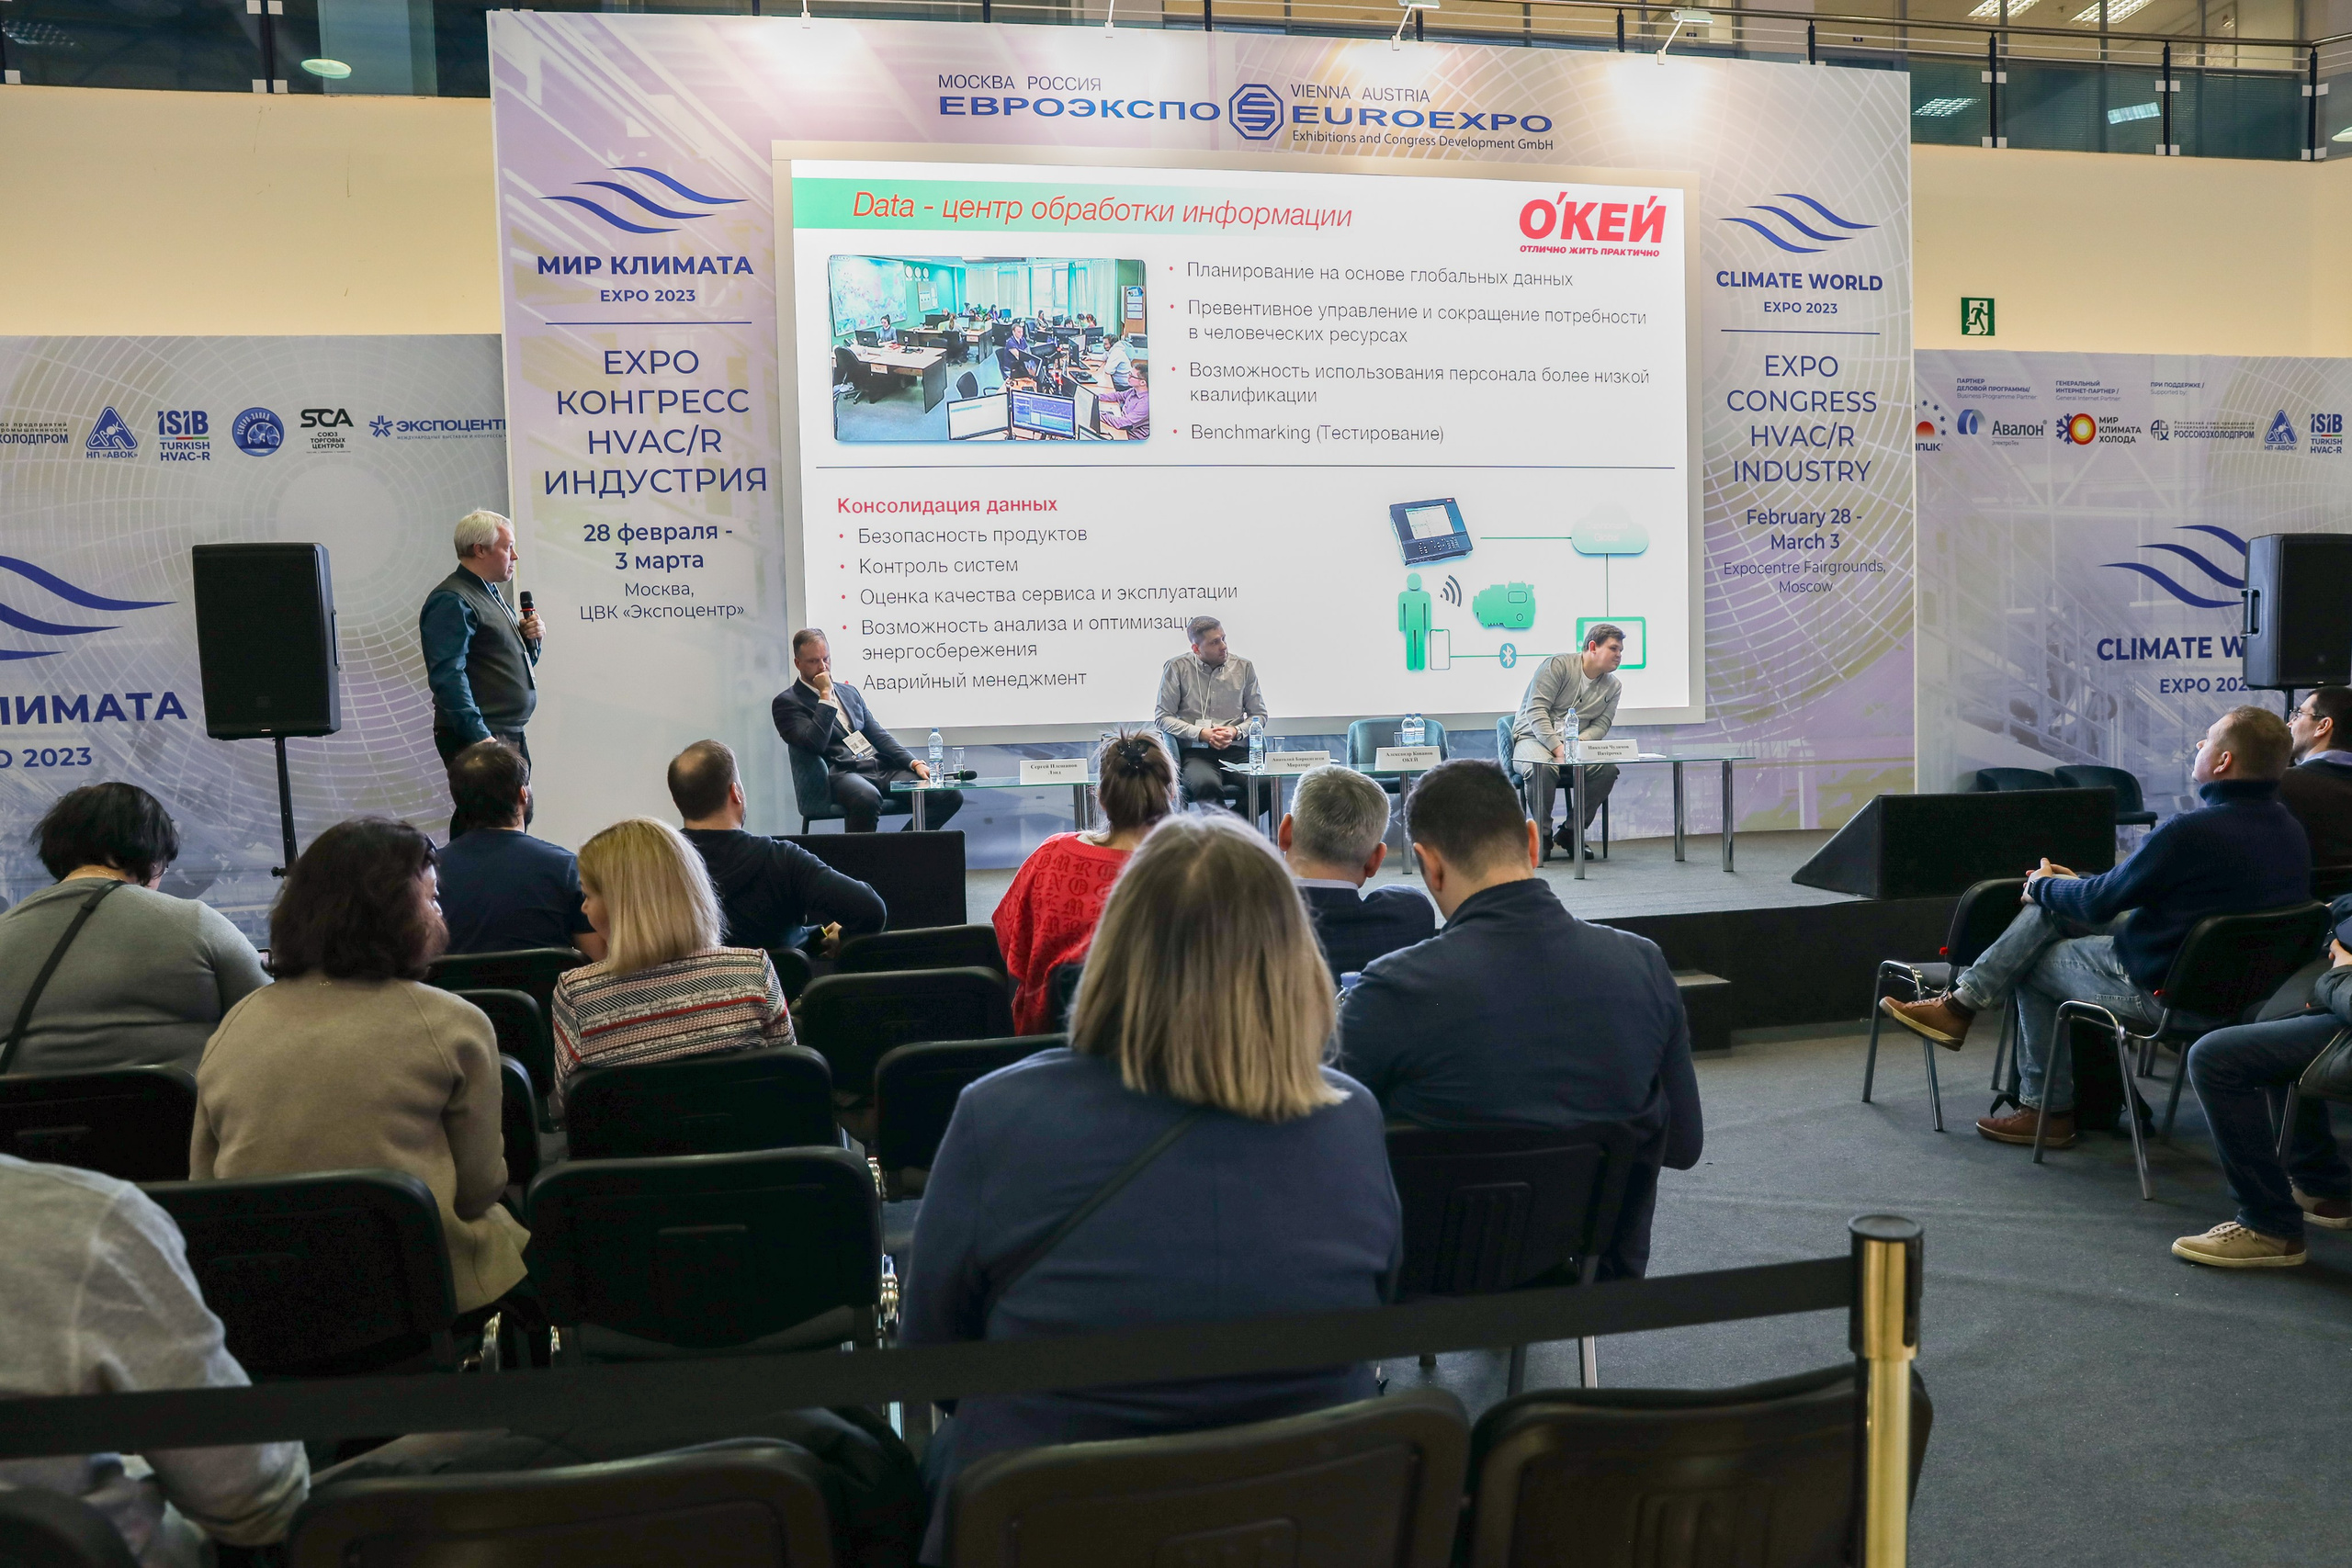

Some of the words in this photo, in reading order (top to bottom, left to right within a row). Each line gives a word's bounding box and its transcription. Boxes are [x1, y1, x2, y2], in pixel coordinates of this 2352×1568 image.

[938, 74, 1014, 90] МОСКВА
[1027, 75, 1102, 91] РОССИЯ
[1290, 84, 1351, 99] VIENNA
[1363, 88, 1430, 103] AUSTRIA
[939, 96, 1220, 121] ЕВРОЭКСПО
[1293, 105, 1554, 133] EUROEXPO
[1293, 130, 1357, 144] Exhibitions
[1359, 132, 1382, 145] and
[1384, 133, 1437, 149] Congress
[1439, 135, 1515, 151] Development
[1518, 138, 1554, 151] GmbH
[853, 191, 915, 218] Data
[943, 196, 1023, 225] центр
[1031, 196, 1175, 226] обработки
[1182, 199, 1352, 229] информации
[1520, 245, 1566, 254] ОТЛИЧНО
[1600, 248, 1659, 257] ПРАКТИЧНО
[537, 256, 602, 275] МИР
[610, 256, 754, 275] КЛИМАТА
[1187, 262, 1315, 281] Планирование
[1319, 268, 1340, 280] на
[1345, 268, 1405, 282] основе
[1410, 267, 1509, 285] глобальных
[1513, 271, 1573, 288] данных
[1716, 270, 1803, 289] CLIMATE
[1809, 273, 1883, 291] WORLD
[600, 290, 650, 302] EXPO
[654, 289, 695, 302] 2023
[1188, 300, 1313, 318] Превентивное
[1317, 304, 1419, 323] управление
[1423, 308, 1432, 320] и
[1438, 308, 1540, 325] сокращение
[1544, 306, 1647, 327] потребности
[1764, 301, 1802, 313] EXPO
[1806, 302, 1838, 314] 2023
[1189, 328, 1198, 340] в
[1204, 328, 1324, 343] человеческих
[1329, 329, 1408, 345] ресурсах
[604, 349, 699, 375] EXPO
[1765, 355, 1838, 378] EXPO
[1190, 362, 1310, 380] Возможность
[1315, 367, 1444, 382] использования
[1449, 368, 1537, 386] персонала
[1542, 367, 1589, 383] более
[1594, 368, 1650, 385] низкой
[557, 389, 750, 416] КОНГРЕСС
[1191, 387, 1317, 407] квалификации
[1727, 389, 1877, 412] CONGRESS
[157, 411, 209, 435] ISIB
[300, 408, 354, 428] SCA
[2098, 416, 2119, 424] МИР
[2311, 413, 2343, 434] ISIB
[588, 424, 722, 457] HVAC/R
[1191, 424, 1310, 445] Benchmarking
[1317, 424, 1444, 446] (Тестирование)
[1751, 423, 1855, 450] HVAC/R
[2098, 435, 2136, 444] ХОЛОДА
[2174, 430, 2255, 439] РОССОЮЗХОЛОДПРОМ
[159, 441, 210, 450] TURKISH
[160, 452, 210, 461] HVAC-R
[1734, 459, 1871, 483] INDUSTRY
[545, 467, 767, 499] ИНДУСТРИЯ
[837, 498, 981, 516] Консолидация
[987, 499, 1058, 514] данных
[1747, 509, 1826, 529] February
[1830, 508, 1851, 525] 28
[583, 524, 613, 542] 28
[617, 523, 718, 546] февраля
[858, 528, 988, 545] Безопасность
[993, 528, 1088, 546] продуктов
[1770, 533, 1825, 550] March
[1829, 533, 1840, 549] 3
[615, 552, 628, 570] 3
[635, 555, 704, 574] марта
[859, 558, 948, 576] Контроль
[954, 559, 1018, 573] систем
[1724, 560, 1800, 577] Expocentre
[1804, 558, 1886, 577] Fairgrounds,
[625, 582, 694, 599] Москва,
[860, 589, 929, 606] Оценка
[934, 589, 1016, 604] качества
[1022, 587, 1095, 604] сервиса
[1102, 588, 1112, 600] и
[1117, 584, 1238, 604] эксплуатации
[1779, 580, 1833, 593] Moscow
[580, 604, 618, 621] ЦВК
[623, 604, 744, 624] «Экспоцентр»
[862, 618, 989, 635] Возможность
[994, 619, 1067, 633] анализа
[1073, 619, 1083, 630] и
[1089, 617, 1193, 631] оптимизаци
[863, 641, 1037, 662] энергосбережения
[2097, 637, 2212, 661] CLIMATE
[864, 671, 967, 692] Аварийный
[972, 671, 1087, 689] менеджмент
[2160, 678, 2211, 694] EXPO
[22, 747, 92, 768] 2023
